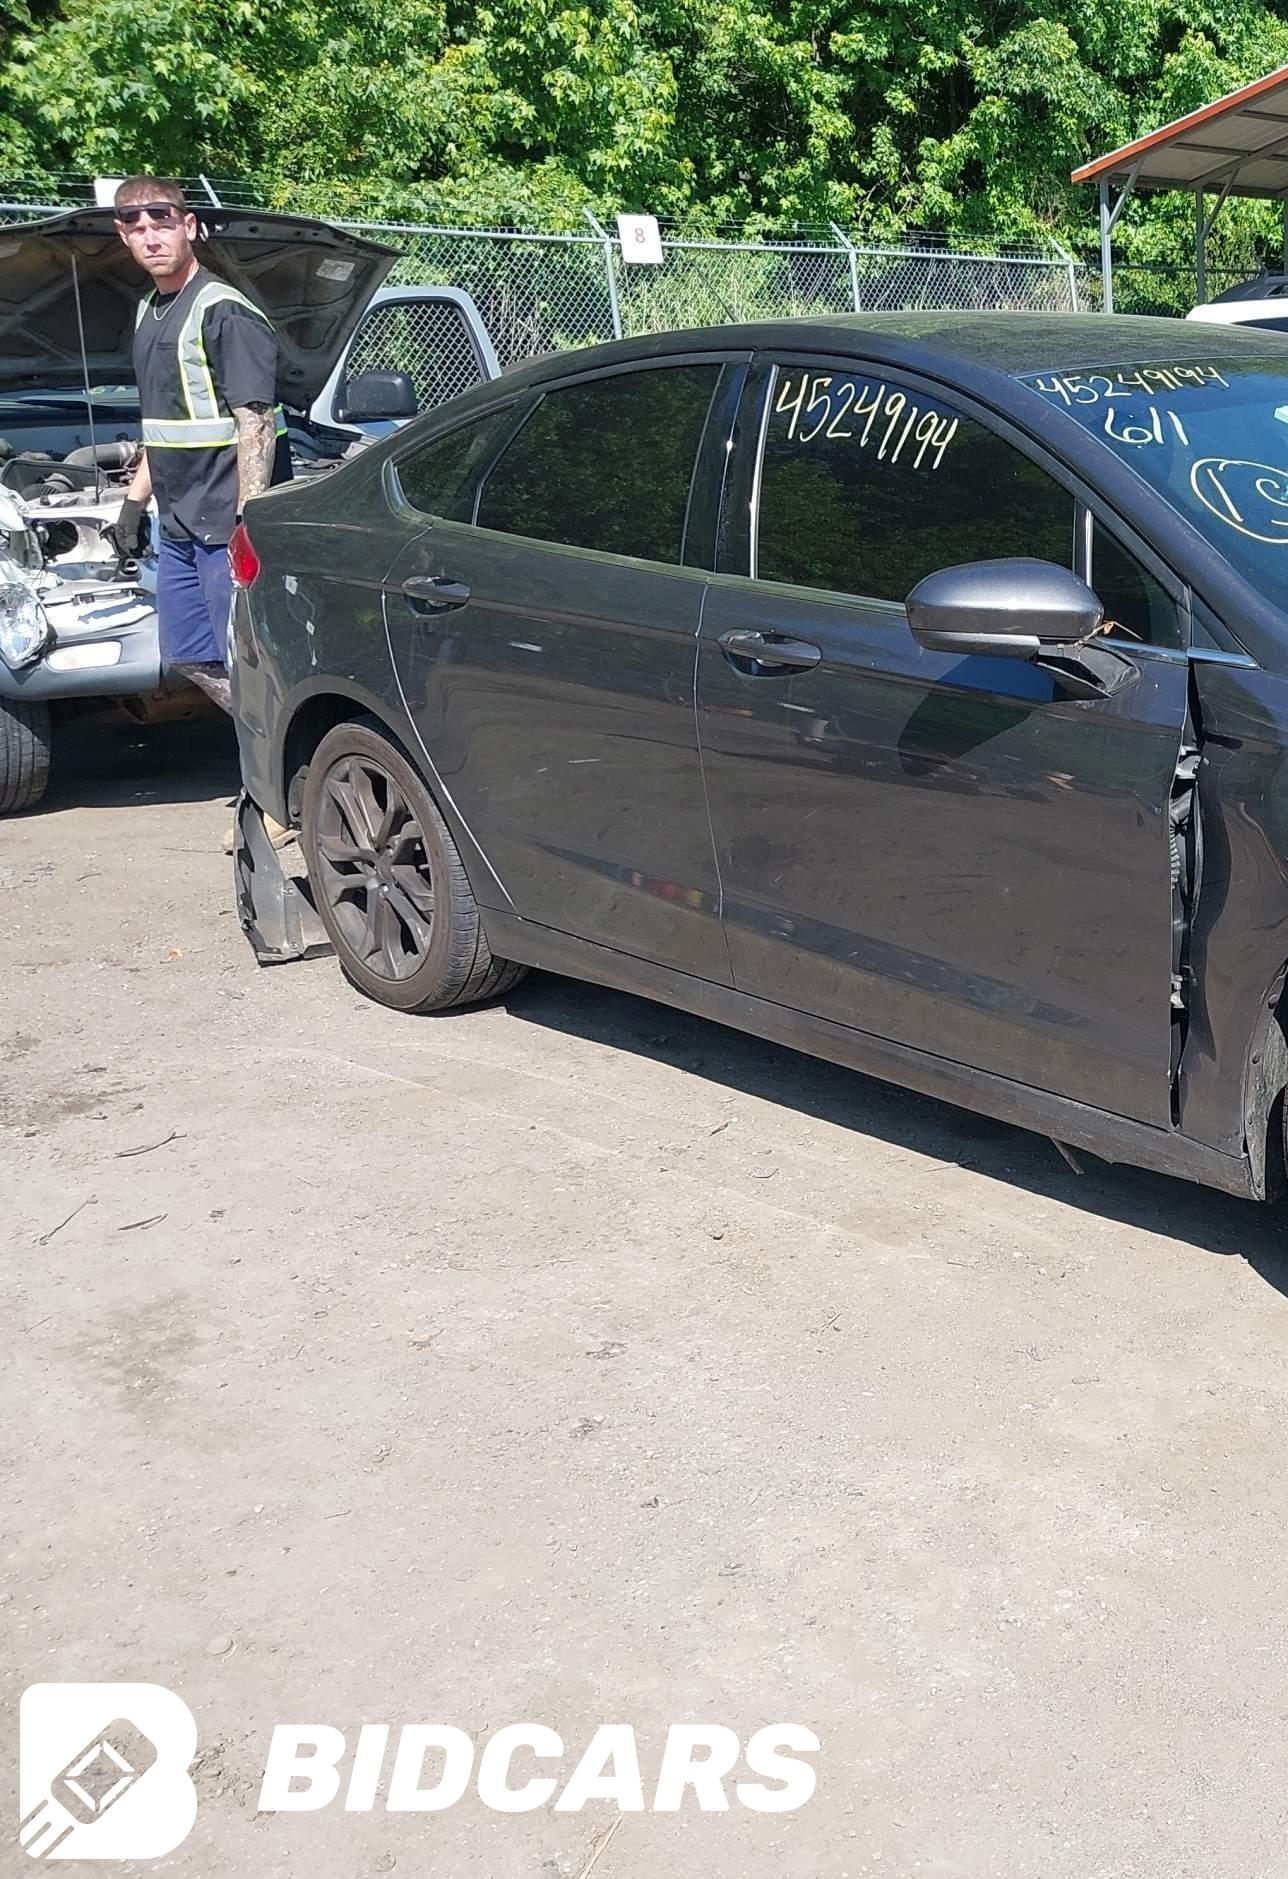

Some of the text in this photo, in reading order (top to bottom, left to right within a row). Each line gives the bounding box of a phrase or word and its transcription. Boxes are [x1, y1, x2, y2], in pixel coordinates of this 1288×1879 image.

[634, 227, 646, 243] 8
[1036, 366, 1230, 406] 45249194
[776, 374, 959, 470] 45249194
